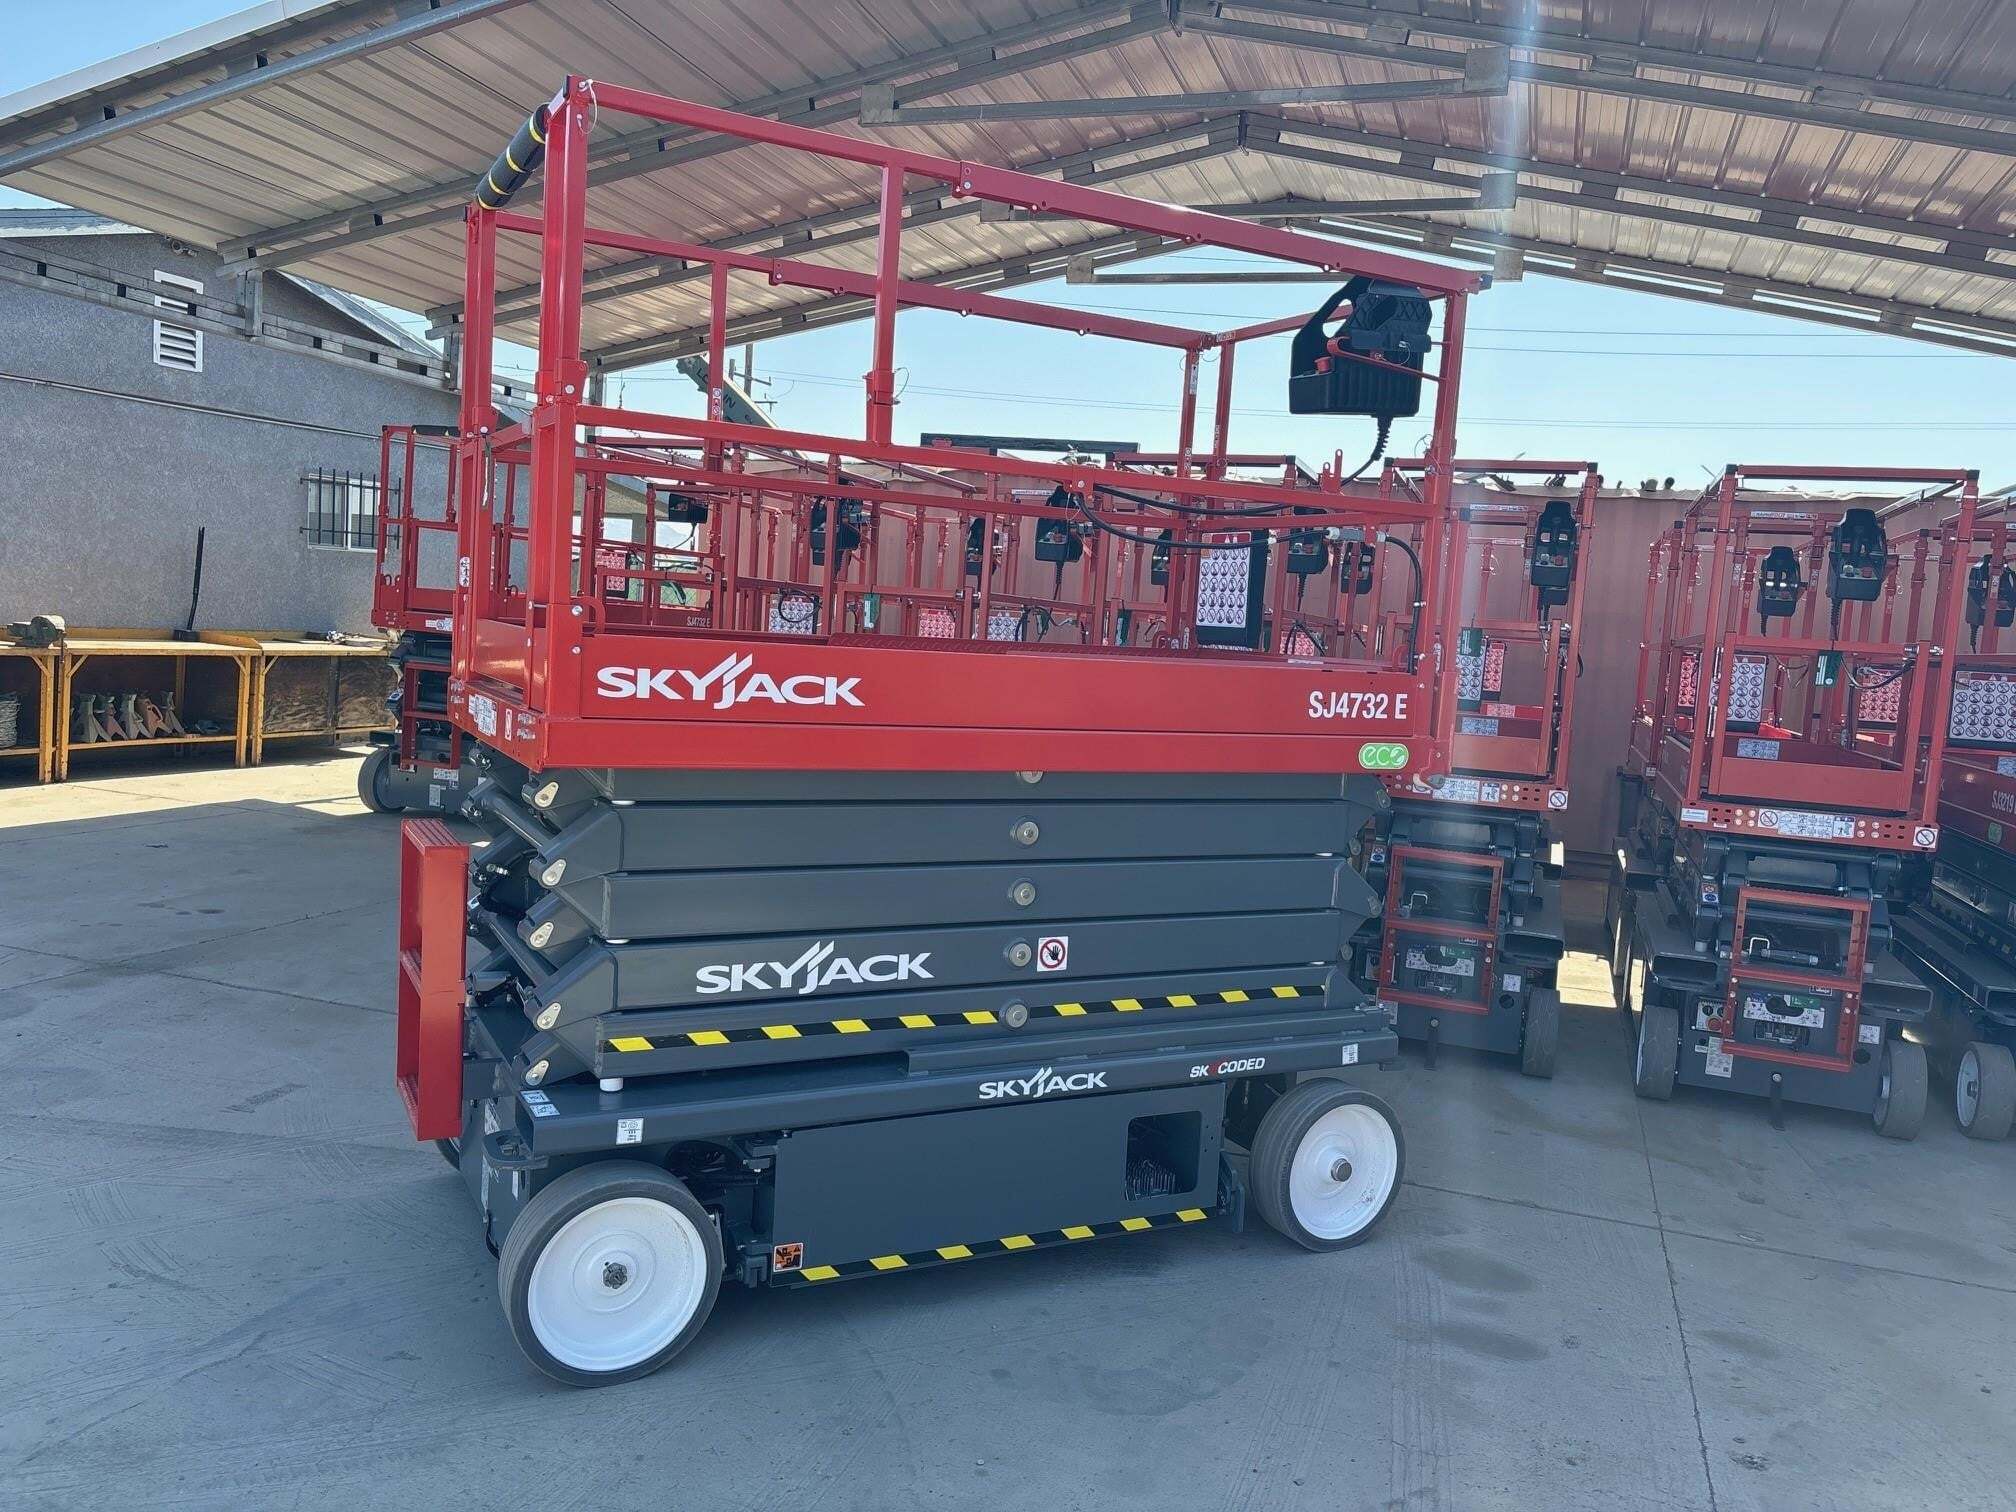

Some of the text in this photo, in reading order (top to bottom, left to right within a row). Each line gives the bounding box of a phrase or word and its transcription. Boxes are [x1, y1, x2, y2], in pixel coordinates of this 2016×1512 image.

[596, 652, 866, 709] SKYJACK
[1308, 690, 1408, 719] SJ4732 E
[695, 940, 935, 995] SKYJACK
[979, 1066, 1108, 1099] SKYJACK
